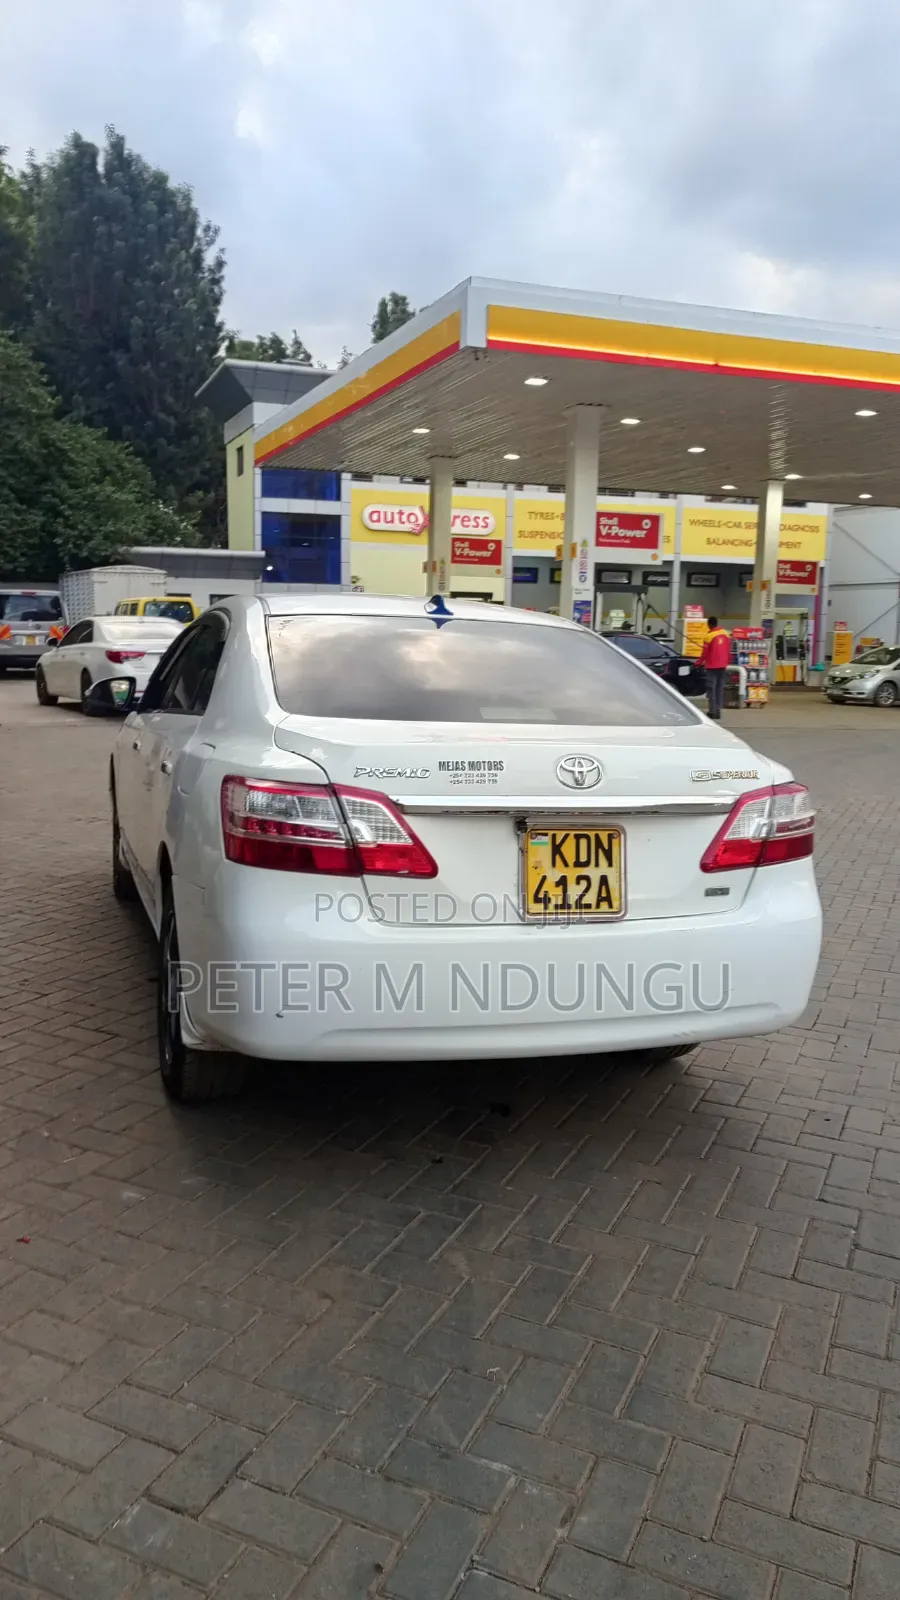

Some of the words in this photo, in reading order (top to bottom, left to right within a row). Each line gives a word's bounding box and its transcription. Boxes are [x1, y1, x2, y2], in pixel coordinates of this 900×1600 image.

[599, 517, 618, 525] Shell
[600, 526, 647, 538] V-Power
[454, 548, 492, 557] V-Power
[438, 761, 465, 771] MEJAS
[468, 761, 504, 771] MOTORS
[353, 767, 431, 779] PREMIO
[551, 833, 613, 868] KDN
[533, 875, 613, 909] 412A
